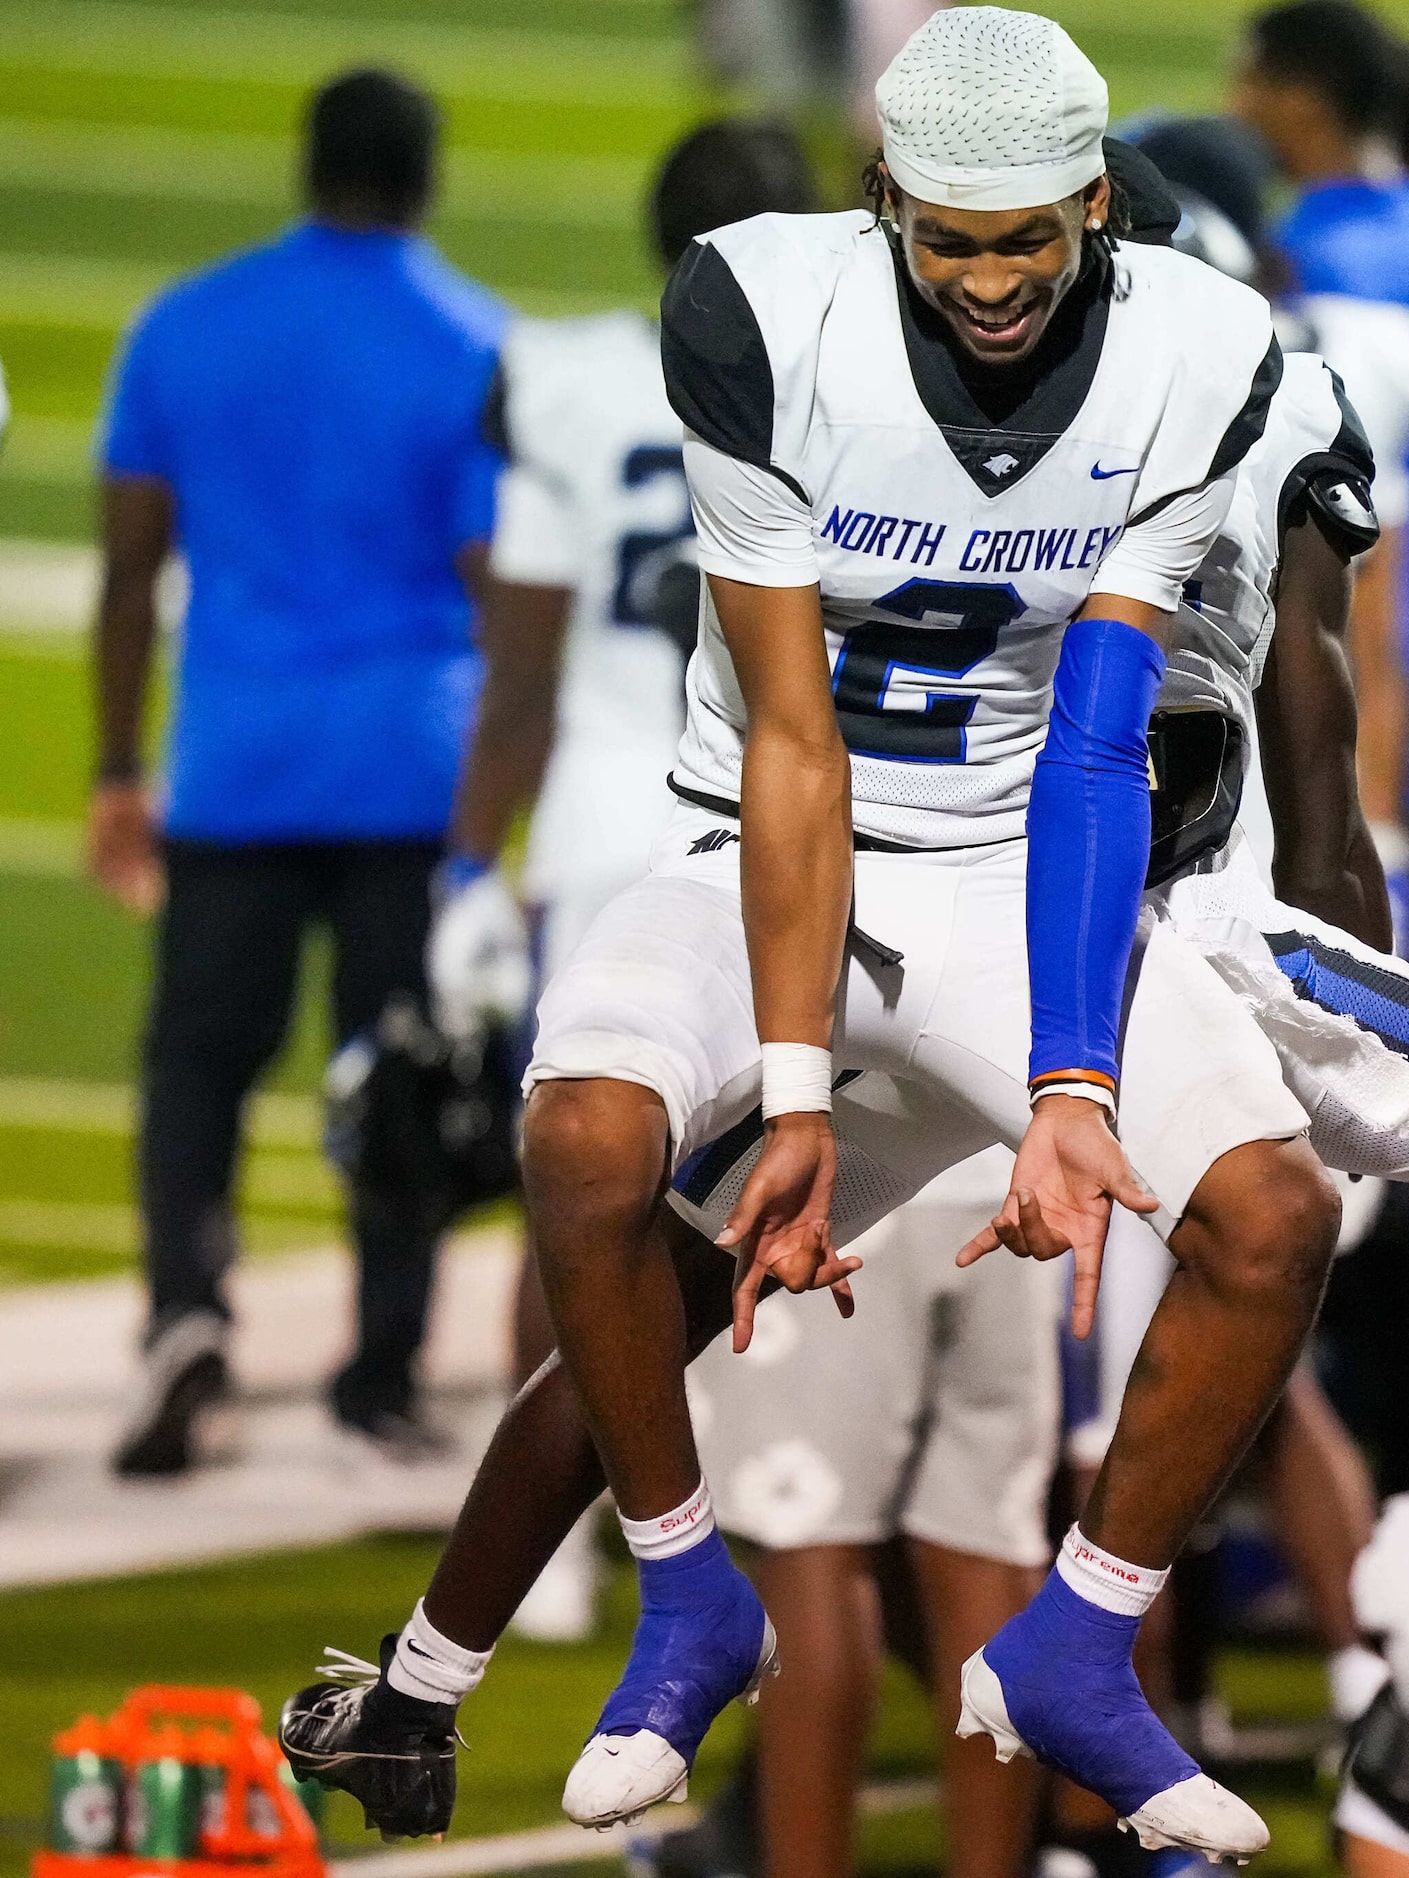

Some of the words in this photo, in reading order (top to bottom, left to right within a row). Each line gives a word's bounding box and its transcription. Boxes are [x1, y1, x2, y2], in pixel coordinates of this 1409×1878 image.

[820, 503, 947, 566] NORTH
[958, 524, 1122, 573] CROWLEY
[831, 576, 1029, 763] 2
